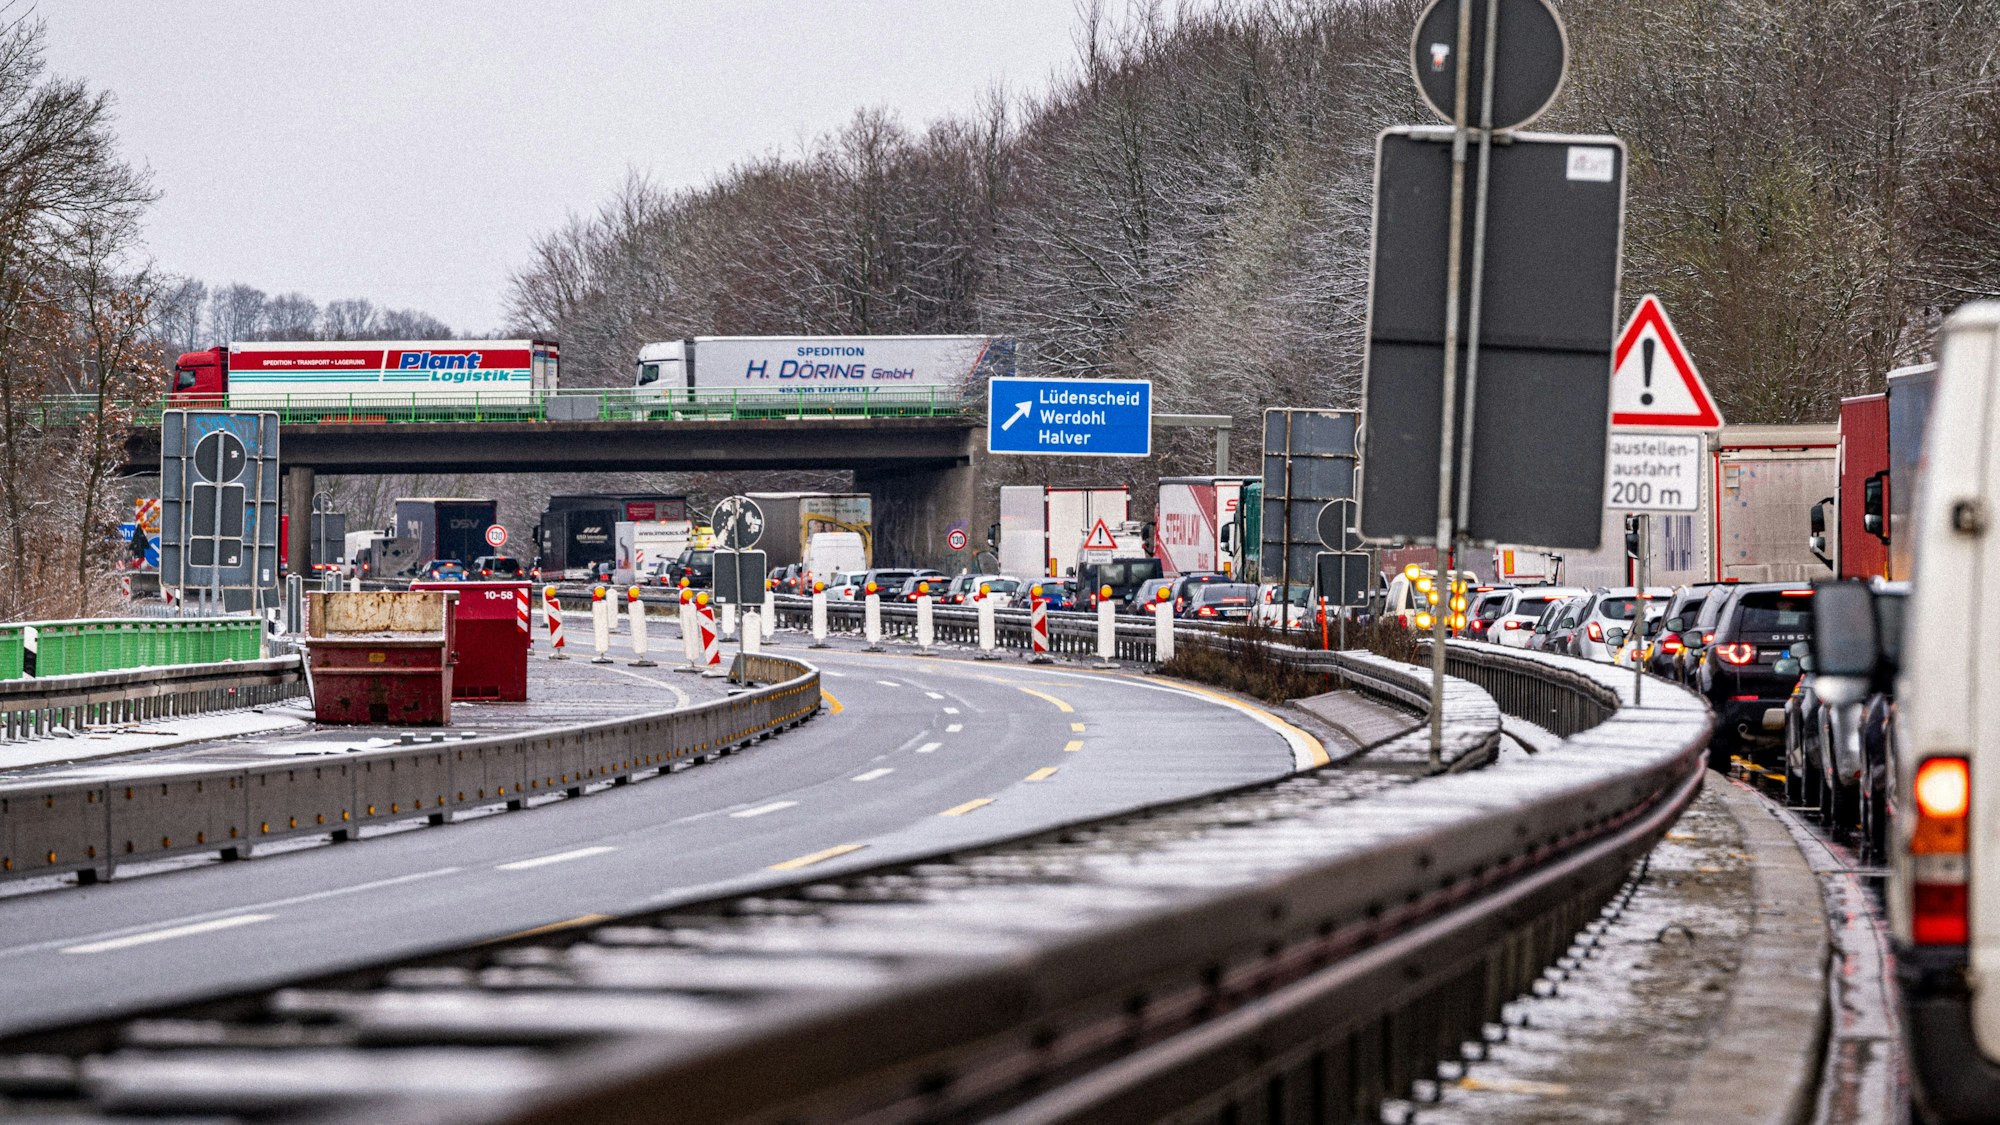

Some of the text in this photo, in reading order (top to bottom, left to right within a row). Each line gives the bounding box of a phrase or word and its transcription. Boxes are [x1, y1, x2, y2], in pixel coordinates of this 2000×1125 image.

[797, 347, 865, 357] SPEDITION
[334, 358, 366, 366] LAGERUNG
[399, 351, 483, 371] Plant
[745, 359, 915, 379] H. DÖRING GmbH
[431, 370, 511, 384] Logistik
[1039, 389, 1140, 406] Lüdenscheid
[1040, 409, 1106, 425] Werdohl
[1039, 429, 1092, 445] Halver
[1612, 481, 1682, 504] 200 m
[450, 519, 480, 529] DSV
[490, 531, 502, 541] 130
[952, 535, 963, 545] 130
[484, 590, 514, 600] 10-58
